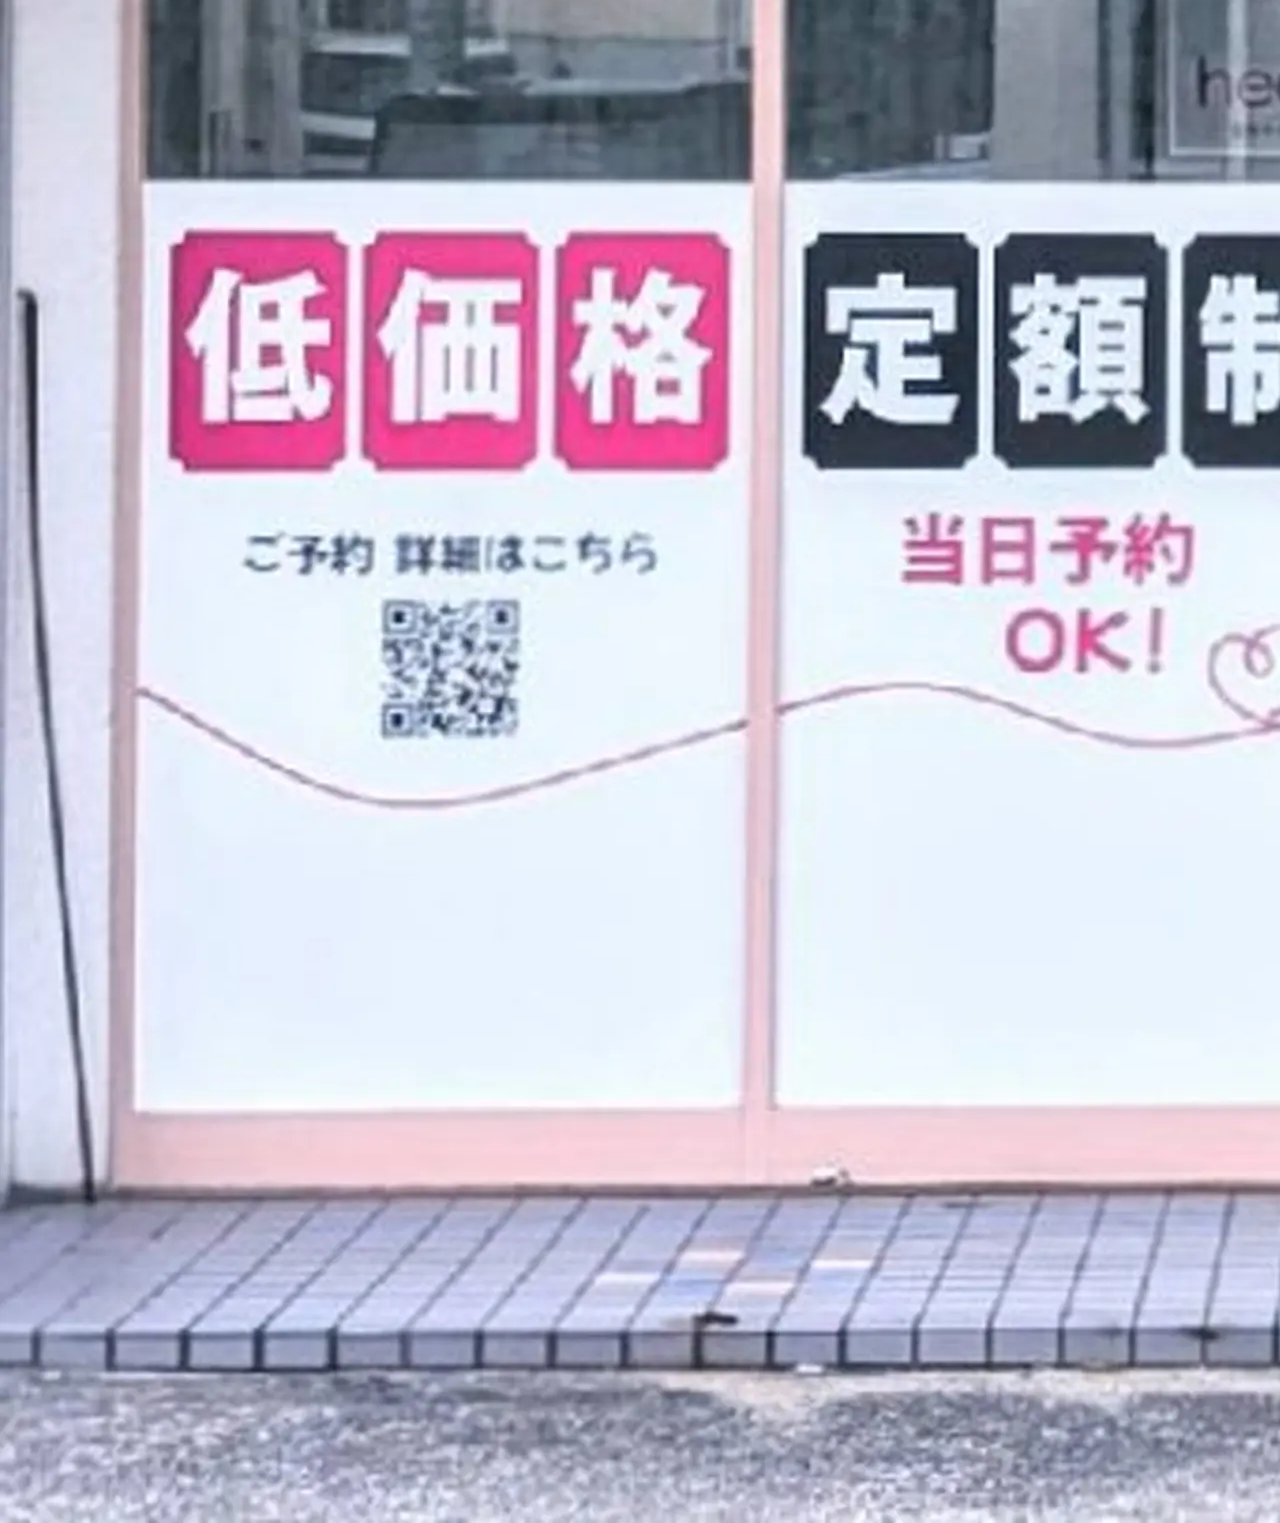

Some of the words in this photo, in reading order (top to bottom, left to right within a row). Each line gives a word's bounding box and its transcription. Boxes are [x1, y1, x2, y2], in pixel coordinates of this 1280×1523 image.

[184, 268, 713, 425] 低価格
[900, 512, 1196, 587] 当日予約
[1004, 606, 1164, 675] OK!
